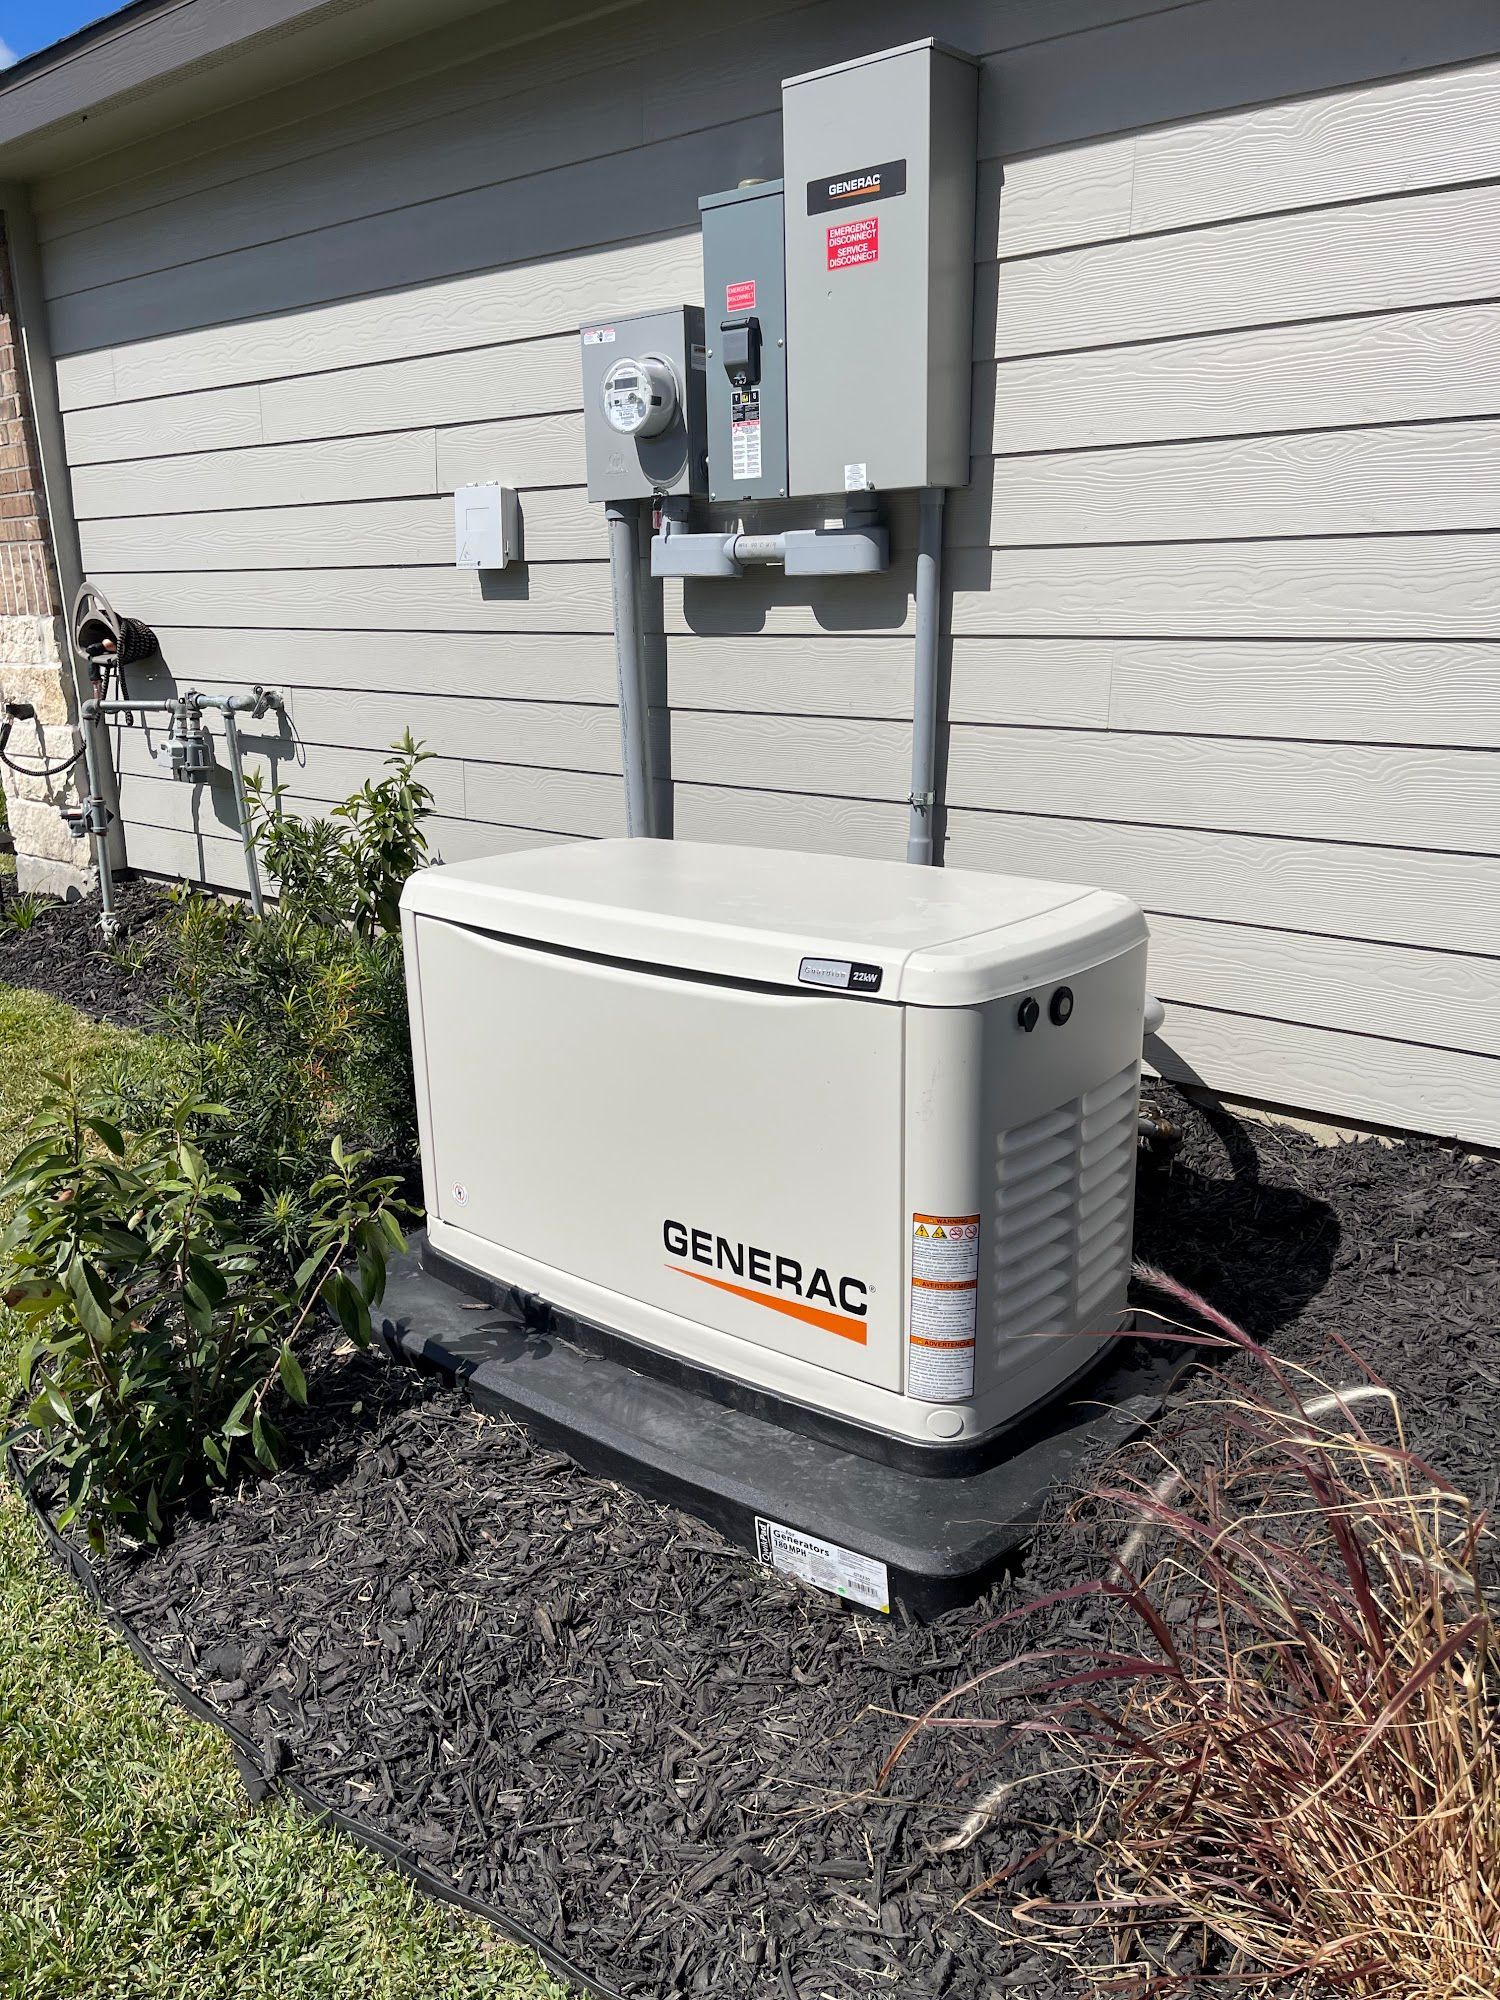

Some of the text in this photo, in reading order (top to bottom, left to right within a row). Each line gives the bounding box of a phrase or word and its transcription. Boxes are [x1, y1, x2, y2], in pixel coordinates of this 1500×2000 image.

[828, 174, 881, 196] GENERAC
[829, 228, 877, 247] DISCONNECT
[830, 220, 876, 238] EMERGENCY
[837, 242, 868, 257] SERVICE
[829, 250, 877, 268] DISCONNECT
[853, 971, 878, 983] 22kW
[936, 1217, 969, 1225] WARNING
[663, 1219, 868, 1316] GENERAC
[922, 1281, 975, 1289] AVERTISSEMENT
[925, 1340, 970, 1348] ADVERTENCIA
[773, 1529, 830, 1557] Generators
[773, 1539, 788, 1551] 180
[788, 1544, 807, 1557] MPH
